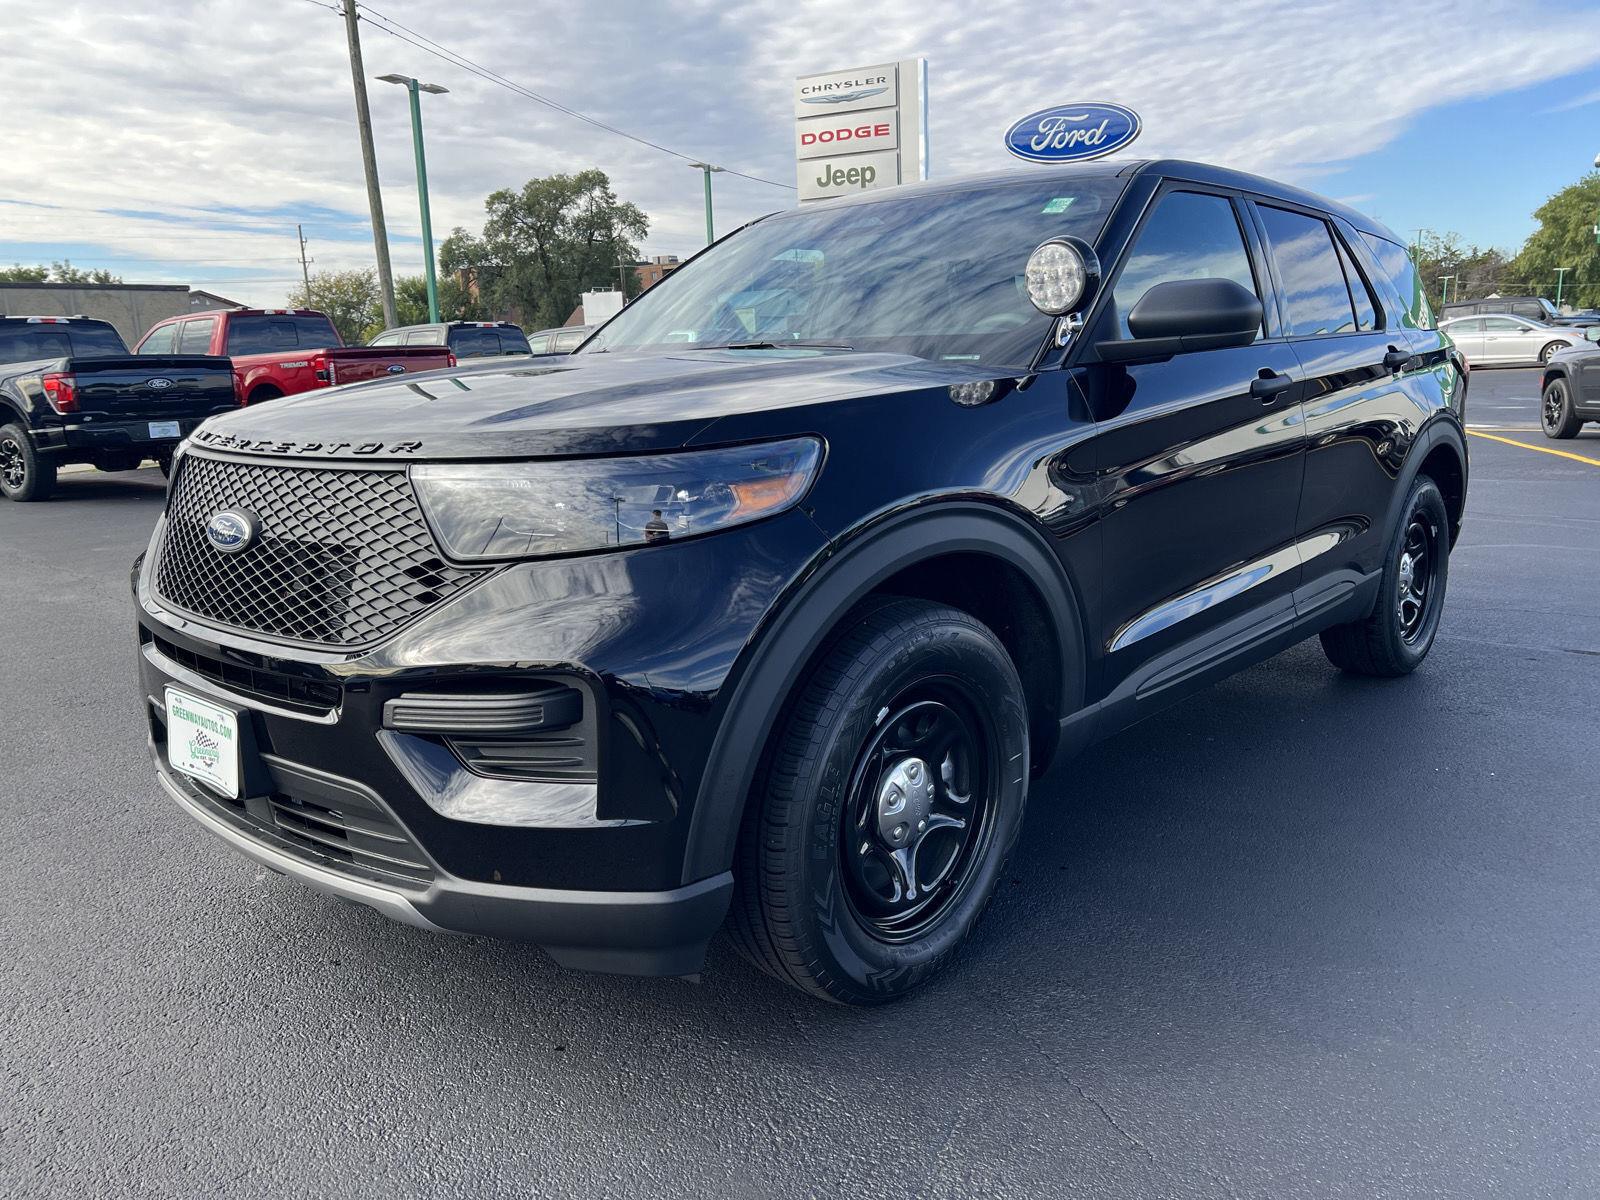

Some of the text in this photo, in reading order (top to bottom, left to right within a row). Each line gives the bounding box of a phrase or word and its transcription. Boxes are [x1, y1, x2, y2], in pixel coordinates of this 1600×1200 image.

[801, 76, 887, 95] CHRYSLER
[801, 123, 891, 146] DODGE
[1030, 114, 1111, 151] Ford
[816, 164, 876, 189] Jeep
[279, 361, 309, 369] TREMOR
[195, 430, 423, 455] INTERCEPTOR
[171, 704, 233, 740] GREENWAYAUTOS.COM
